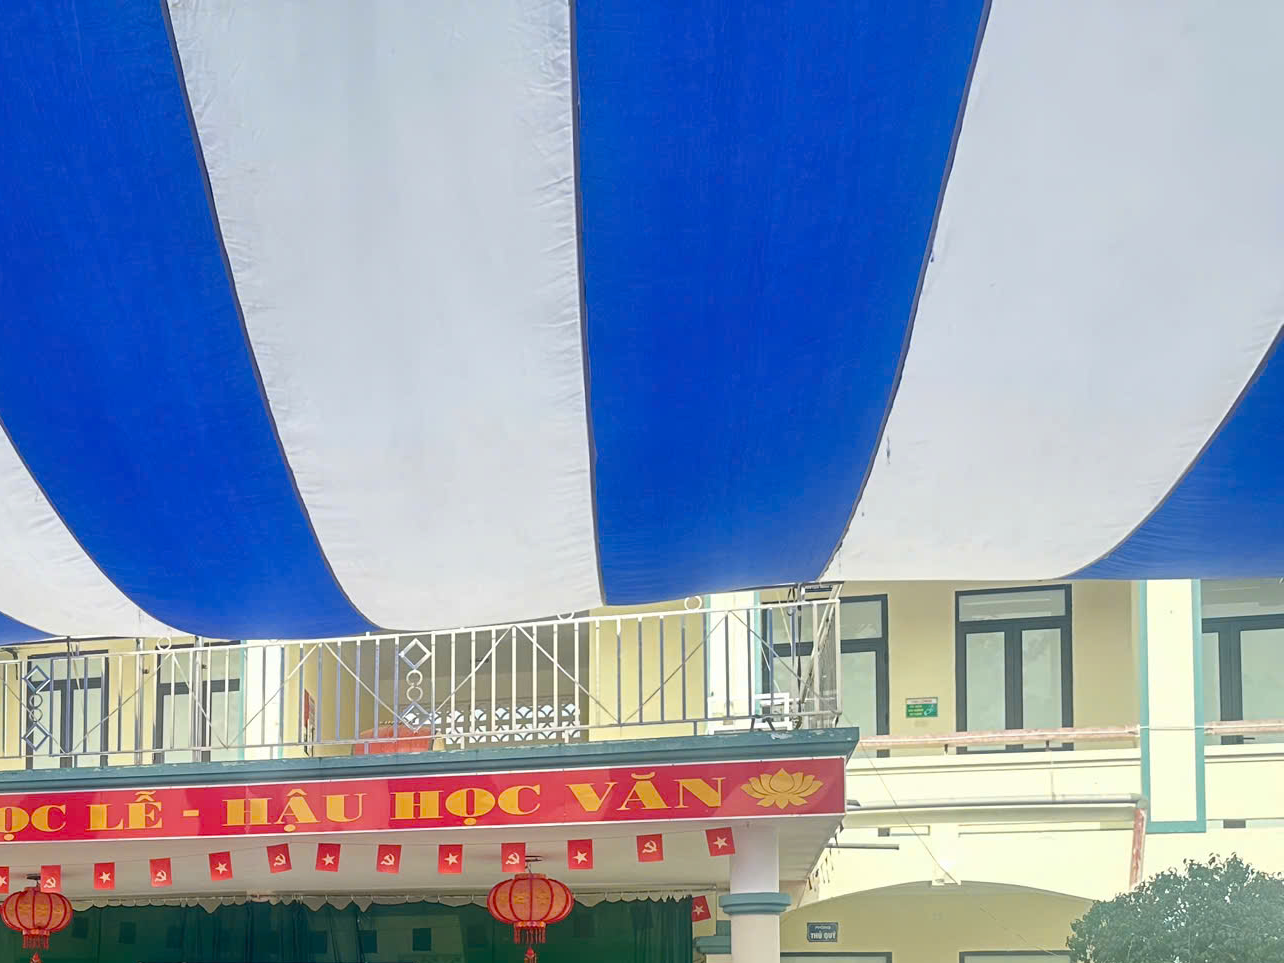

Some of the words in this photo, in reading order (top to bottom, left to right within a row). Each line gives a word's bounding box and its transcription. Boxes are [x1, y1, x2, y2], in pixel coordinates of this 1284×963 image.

[86, 790, 163, 831] LỄ
[221, 788, 366, 832] HẬU
[390, 784, 540, 825] HỌC
[566, 771, 726, 812] VĂN
